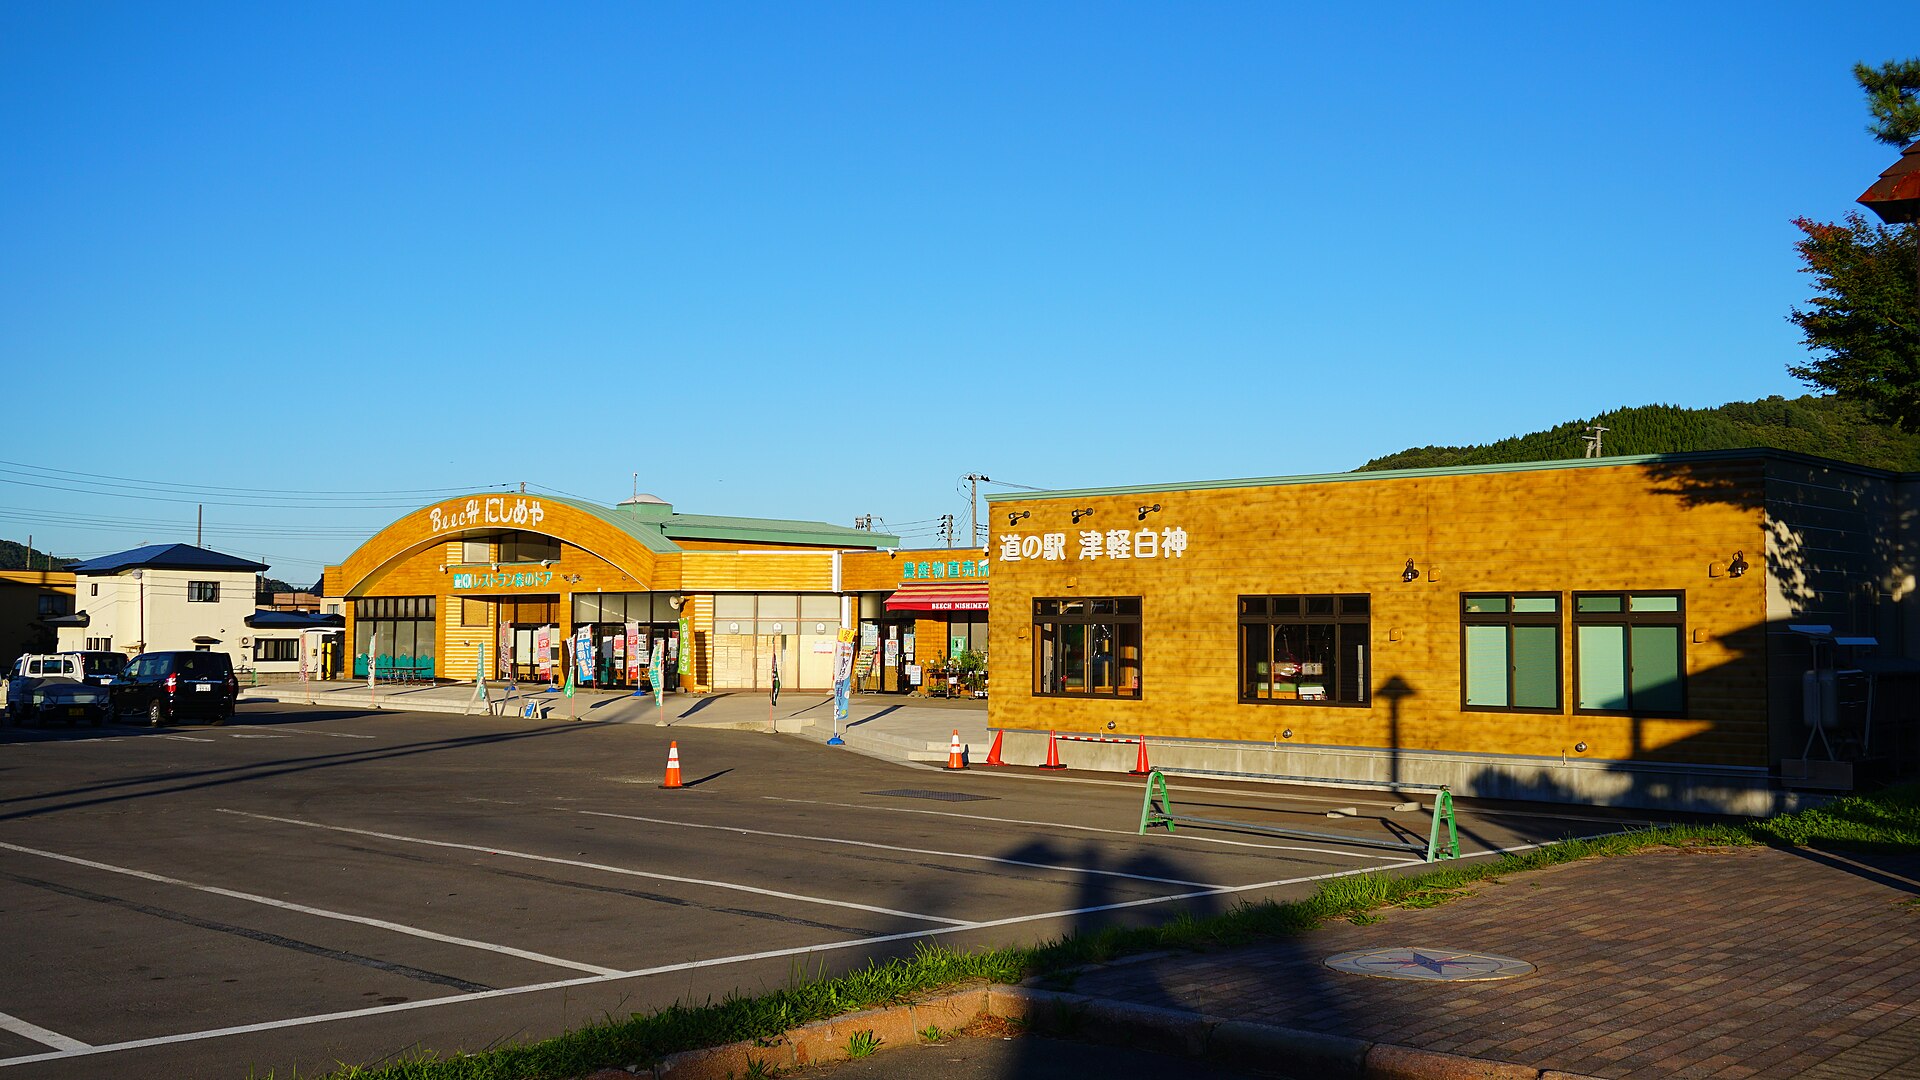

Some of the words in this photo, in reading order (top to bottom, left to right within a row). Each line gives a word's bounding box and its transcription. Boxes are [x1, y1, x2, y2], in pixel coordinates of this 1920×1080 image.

[485, 498, 544, 527] にしめや
[999, 533, 1067, 561] 道の駅
[1078, 526, 1188, 561] 津軽白神
[903, 560, 989, 579] 農産物直売所
